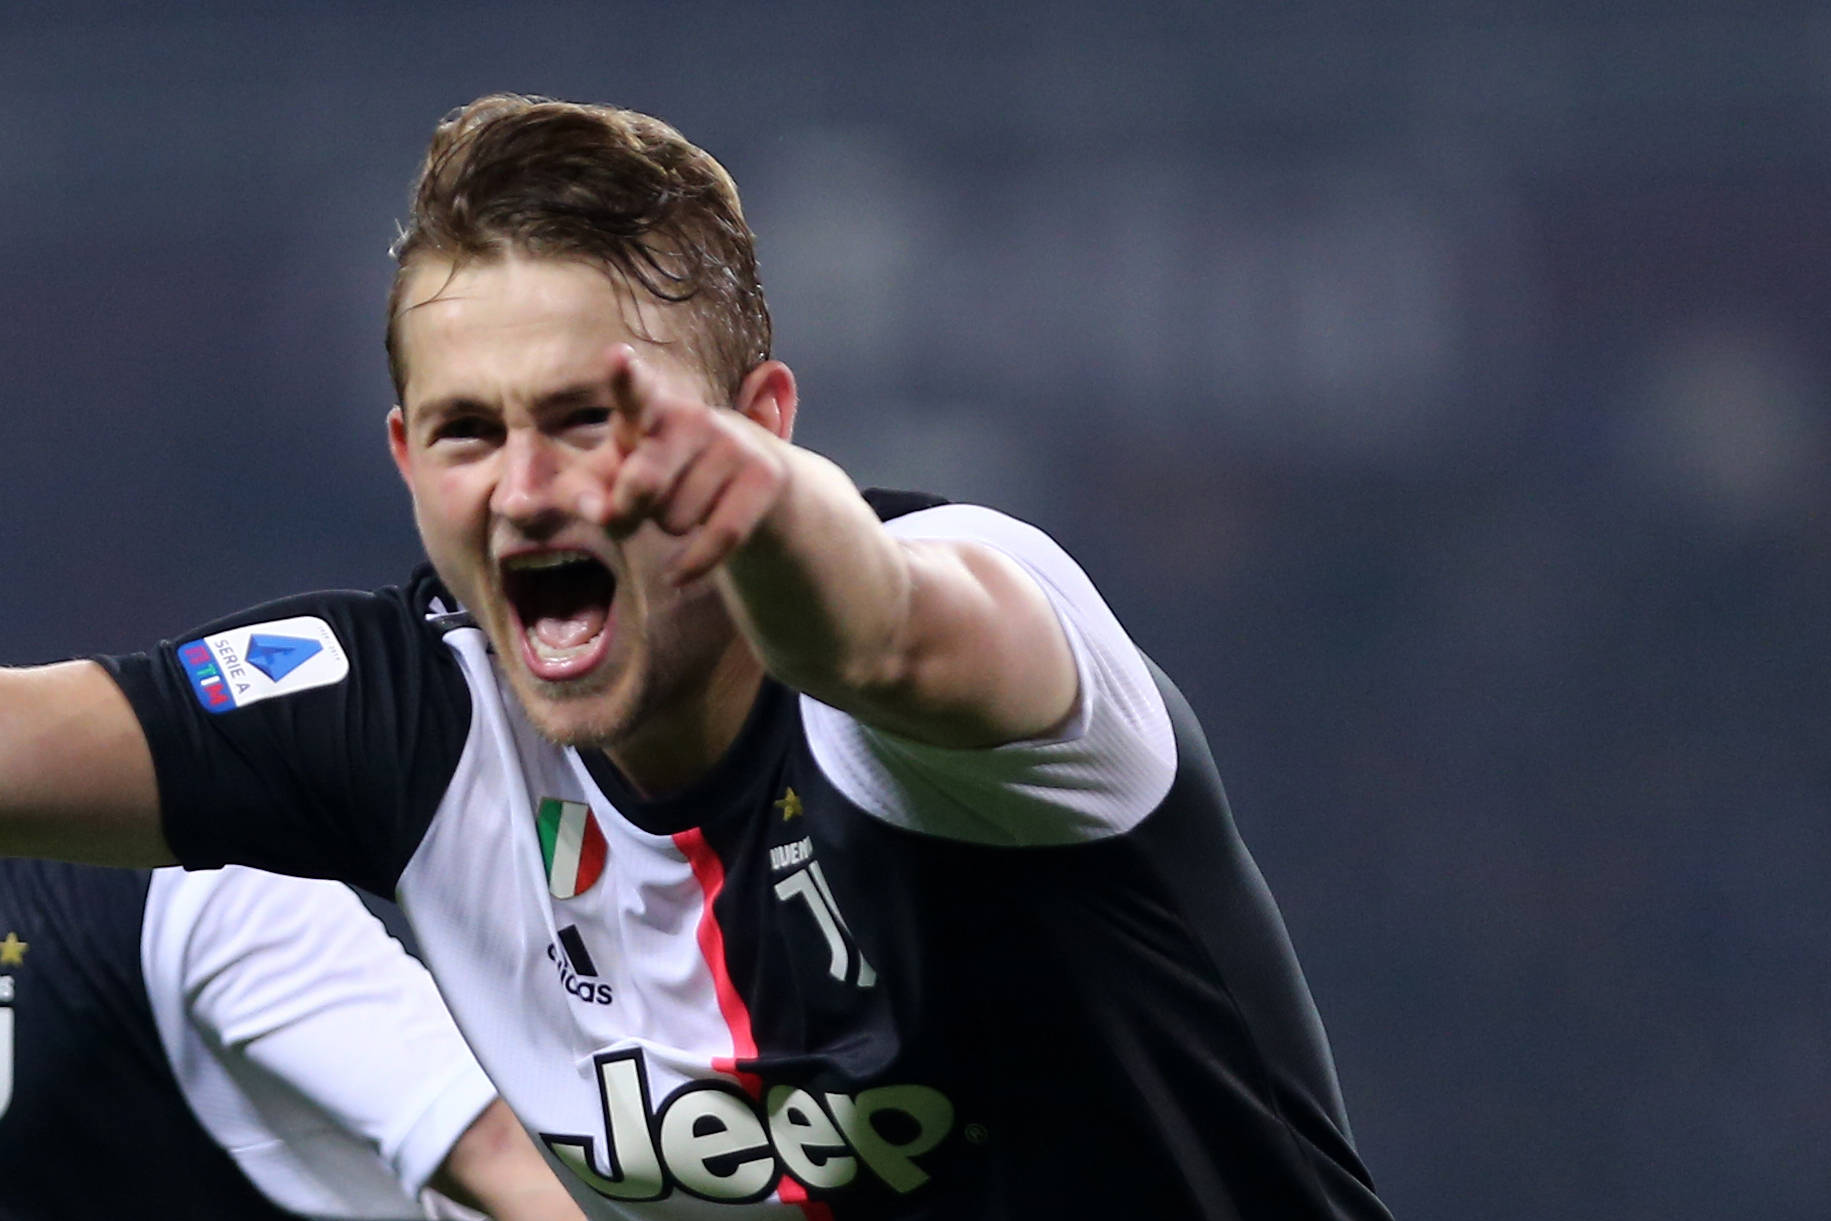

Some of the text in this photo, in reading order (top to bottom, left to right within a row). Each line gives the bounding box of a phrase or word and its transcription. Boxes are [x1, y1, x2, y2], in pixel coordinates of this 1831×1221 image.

[196, 662, 230, 706] TIM
[214, 639, 251, 695] SERIE A
[540, 1047, 955, 1202] Jeep
